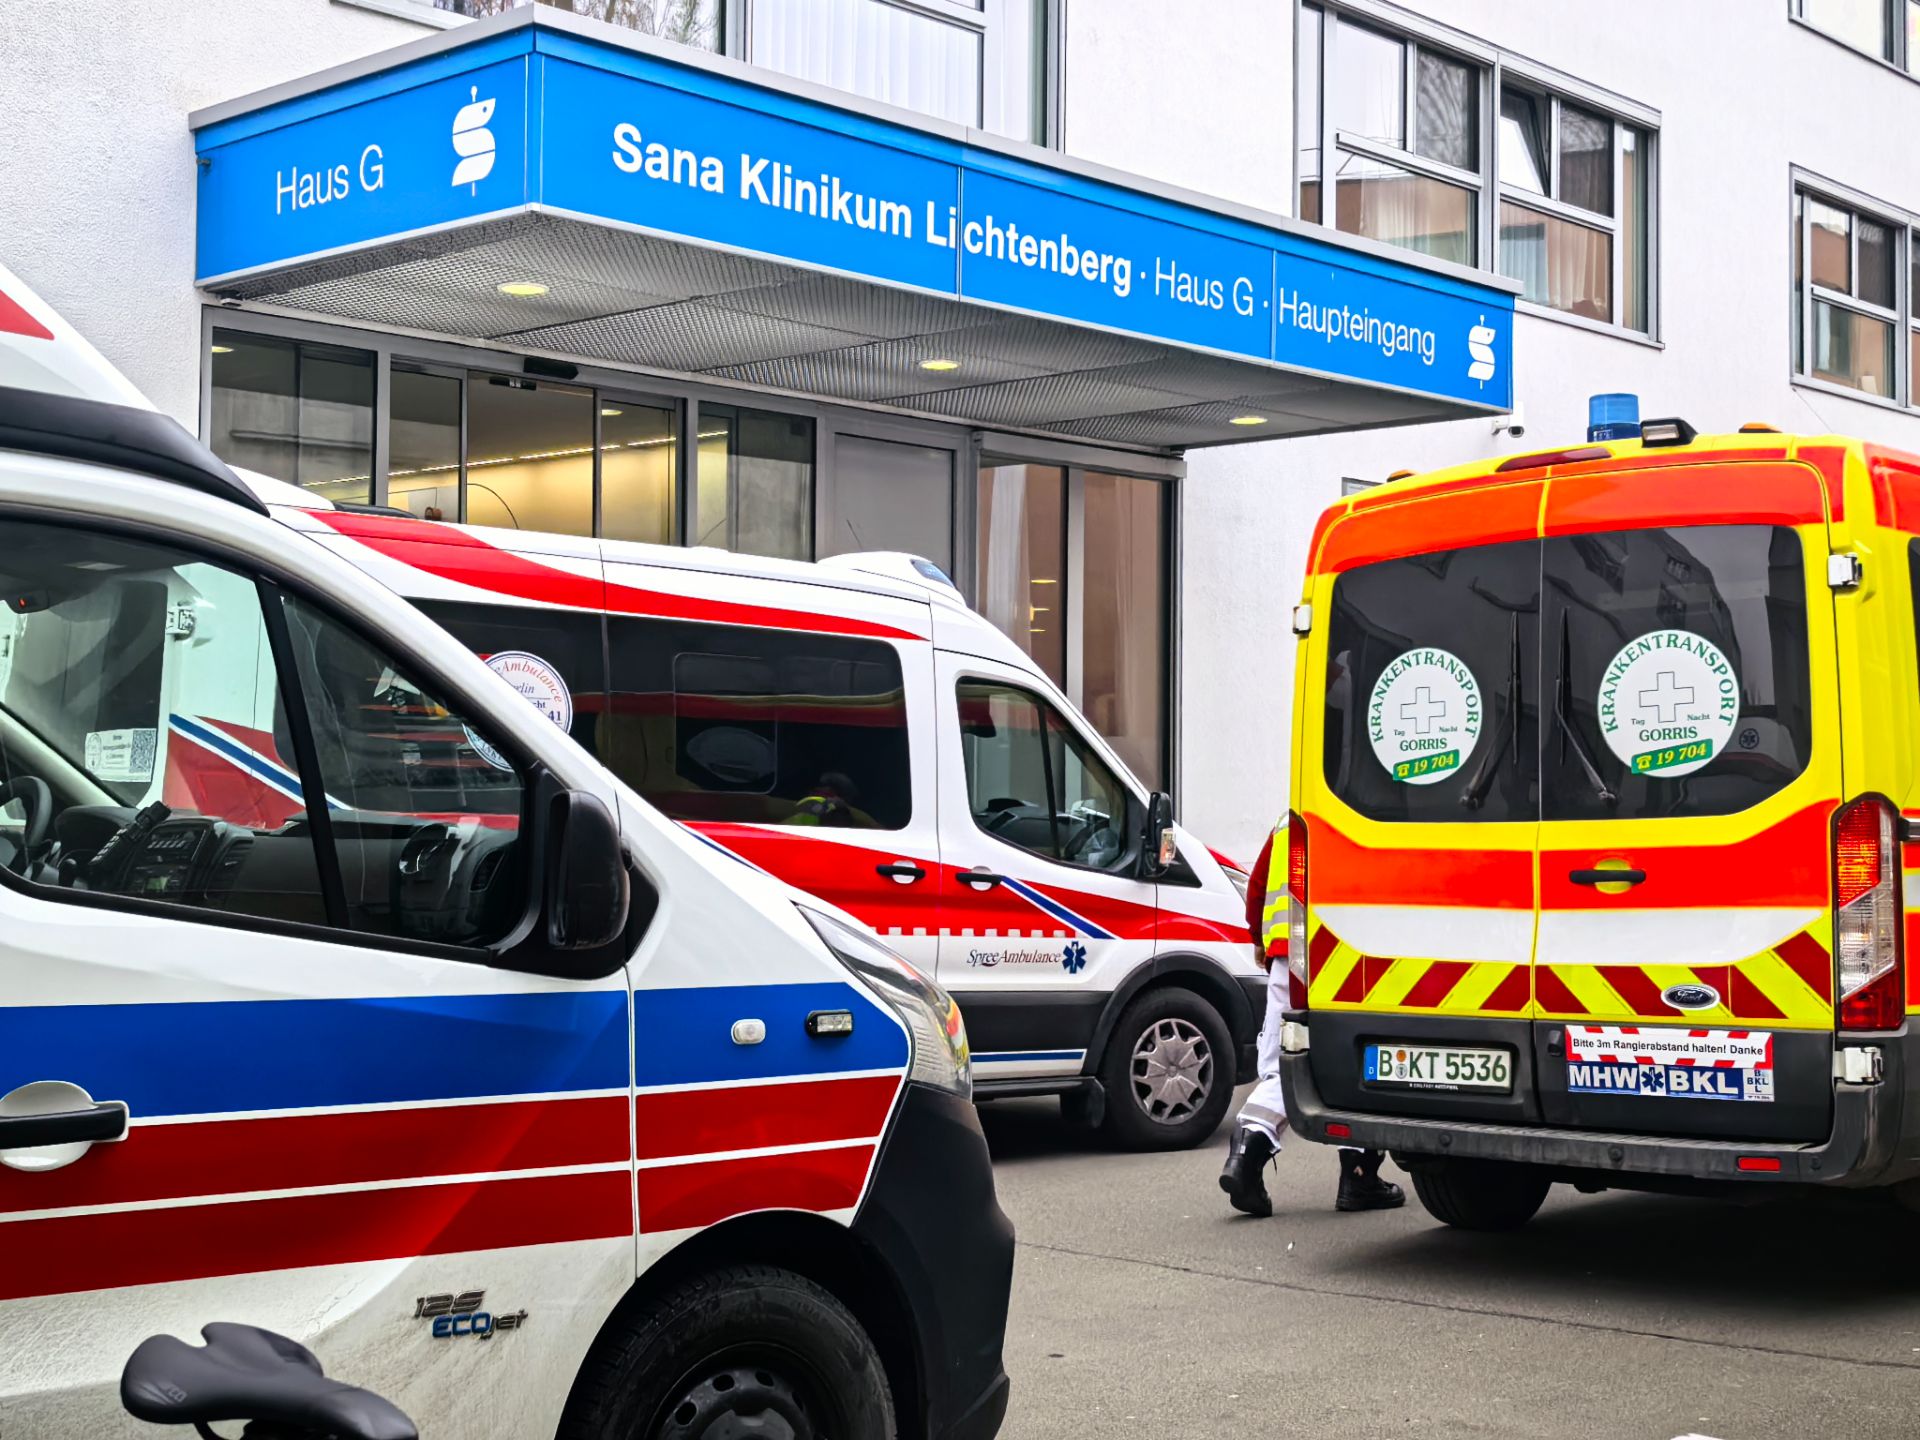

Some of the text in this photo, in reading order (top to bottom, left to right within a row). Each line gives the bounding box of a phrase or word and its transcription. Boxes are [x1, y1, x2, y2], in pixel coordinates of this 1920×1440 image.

[276, 143, 384, 215] Haus G
[612, 122, 1436, 366] Sana Klinikum Lichtenberg Haus G Haupteingang
[1601, 633, 1736, 733] KRANKENTRANSPORT
[1370, 651, 1480, 743] KRANKENTRANSPORT
[1631, 713, 1711, 726] Tag Nacht
[1399, 738, 1448, 752] GORRIS
[1639, 726, 1698, 742] GORRIS
[1413, 753, 1454, 773] 19 704
[1656, 743, 1707, 765] 19 704
[1573, 1038, 1763, 1056] Bitte 3m Rangierabstand halten! Danke
[1379, 1049, 1393, 1077] B
[1409, 1051, 1440, 1079] KT
[1445, 1053, 1507, 1083] 5536
[1568, 1064, 1739, 1095] MHW BKL
